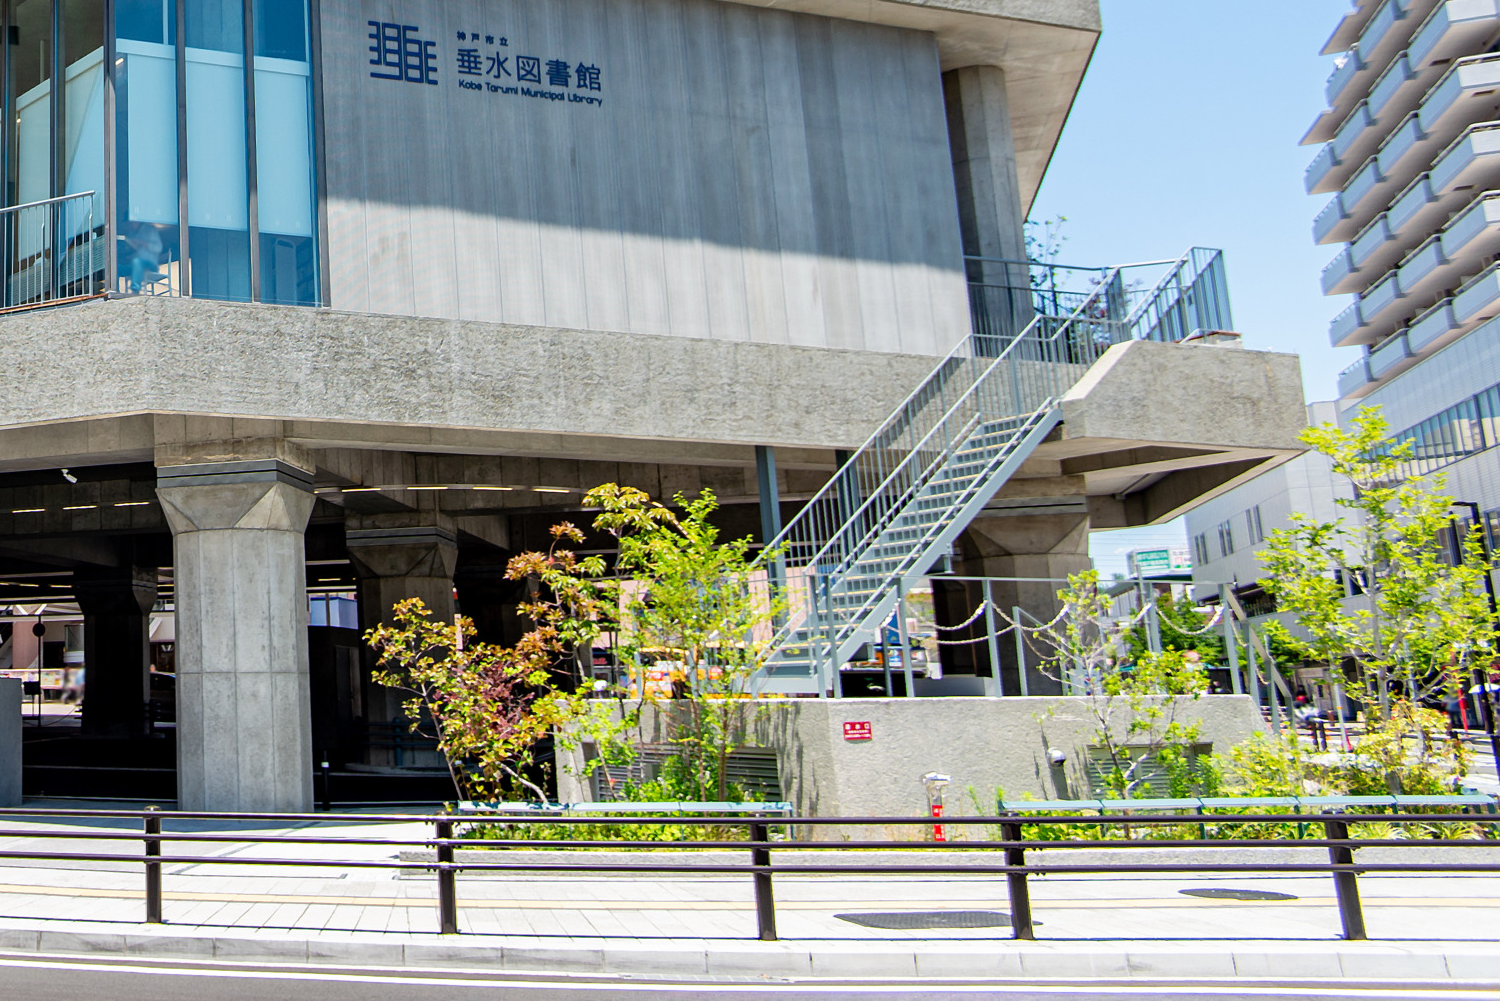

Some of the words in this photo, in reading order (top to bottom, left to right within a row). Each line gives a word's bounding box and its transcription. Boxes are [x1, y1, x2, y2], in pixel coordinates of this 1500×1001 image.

[456, 30, 509, 47] 神戸市立
[456, 48, 602, 92] 垂水図書館
[458, 78, 483, 91] Kobe
[485, 81, 519, 95] Tarumi
[520, 87, 566, 102] Municipal
[567, 92, 603, 107] Library
